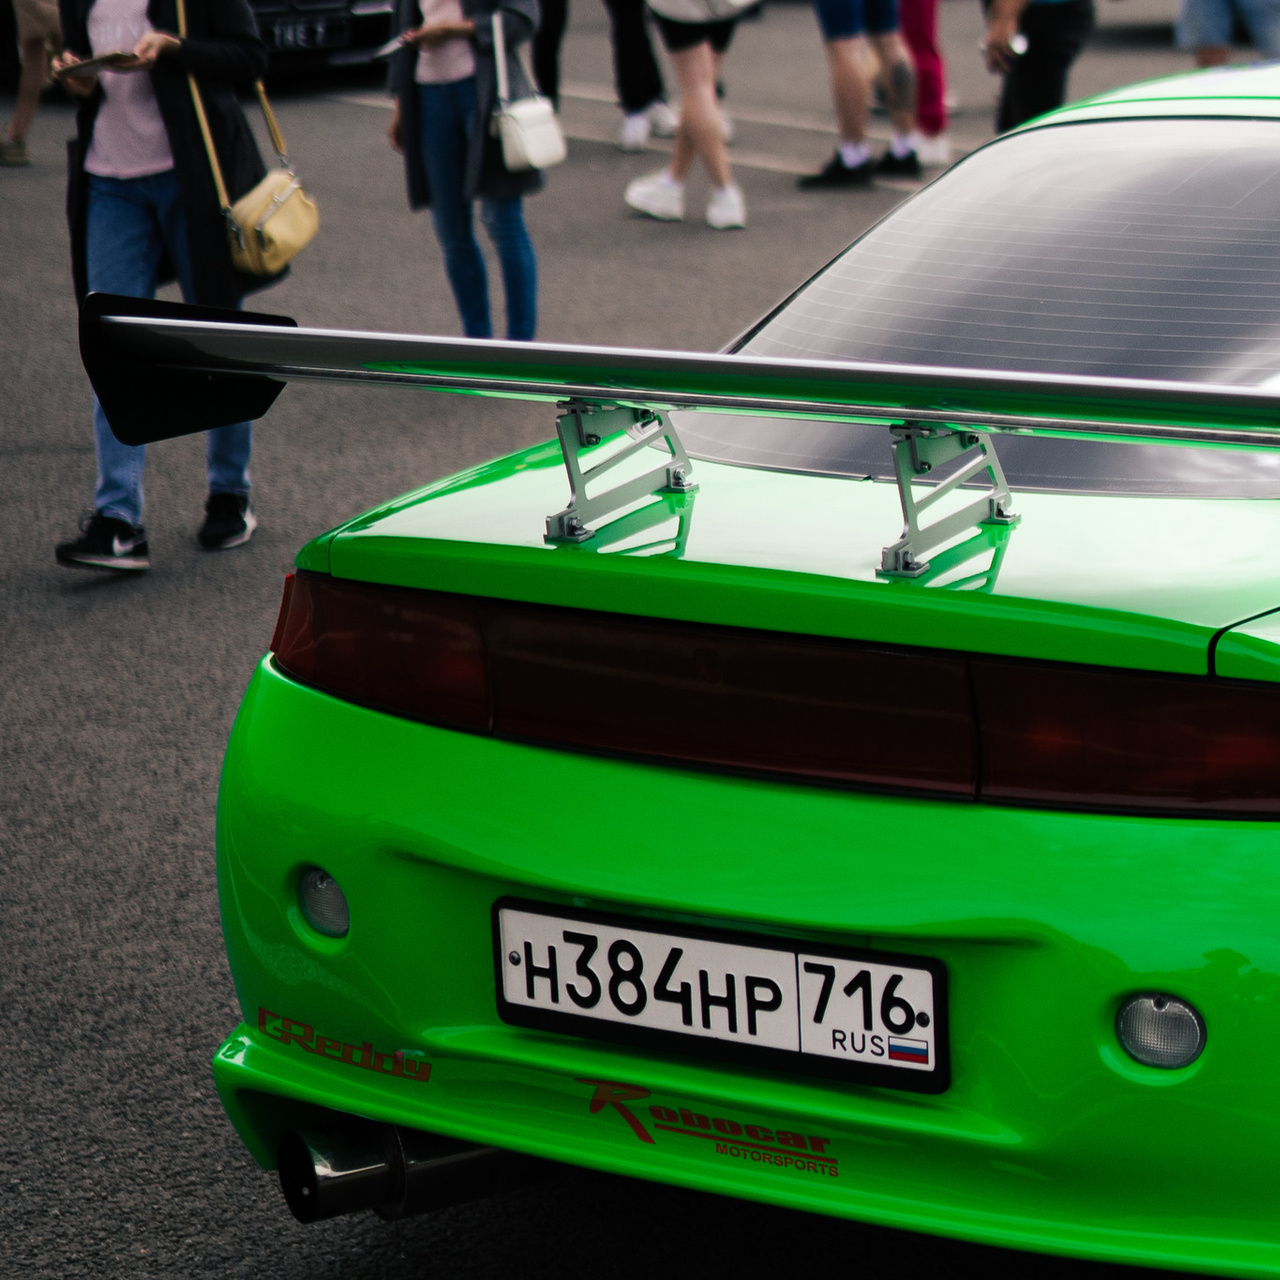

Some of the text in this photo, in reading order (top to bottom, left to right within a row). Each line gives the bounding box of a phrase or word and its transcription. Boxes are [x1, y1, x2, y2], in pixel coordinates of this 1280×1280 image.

[803, 961, 917, 1035] 716
[257, 1006, 432, 1083] GReddy
[831, 1029, 885, 1057] RUS
[573, 1077, 831, 1154] Robocar
[716, 1143, 839, 1178] MOTORSPORTS
